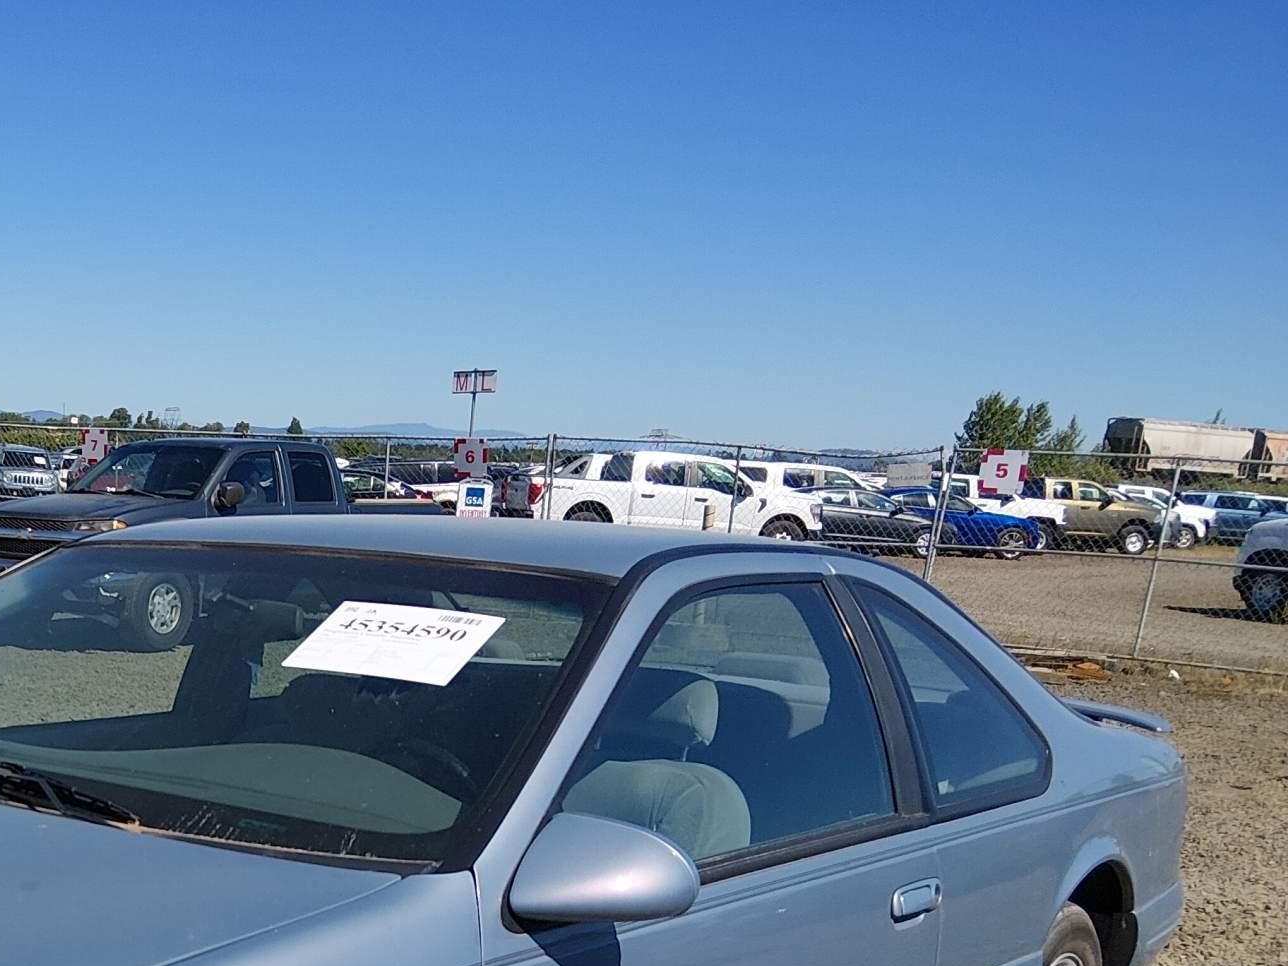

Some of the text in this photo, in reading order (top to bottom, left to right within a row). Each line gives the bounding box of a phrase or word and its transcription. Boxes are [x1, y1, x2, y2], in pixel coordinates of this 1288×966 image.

[456, 372, 492, 391] M L
[91, 440, 98, 451] 7
[465, 450, 475, 464] 6
[995, 463, 1009, 479] 5
[466, 496, 483, 505] GSA
[339, 618, 467, 642] 45354590
